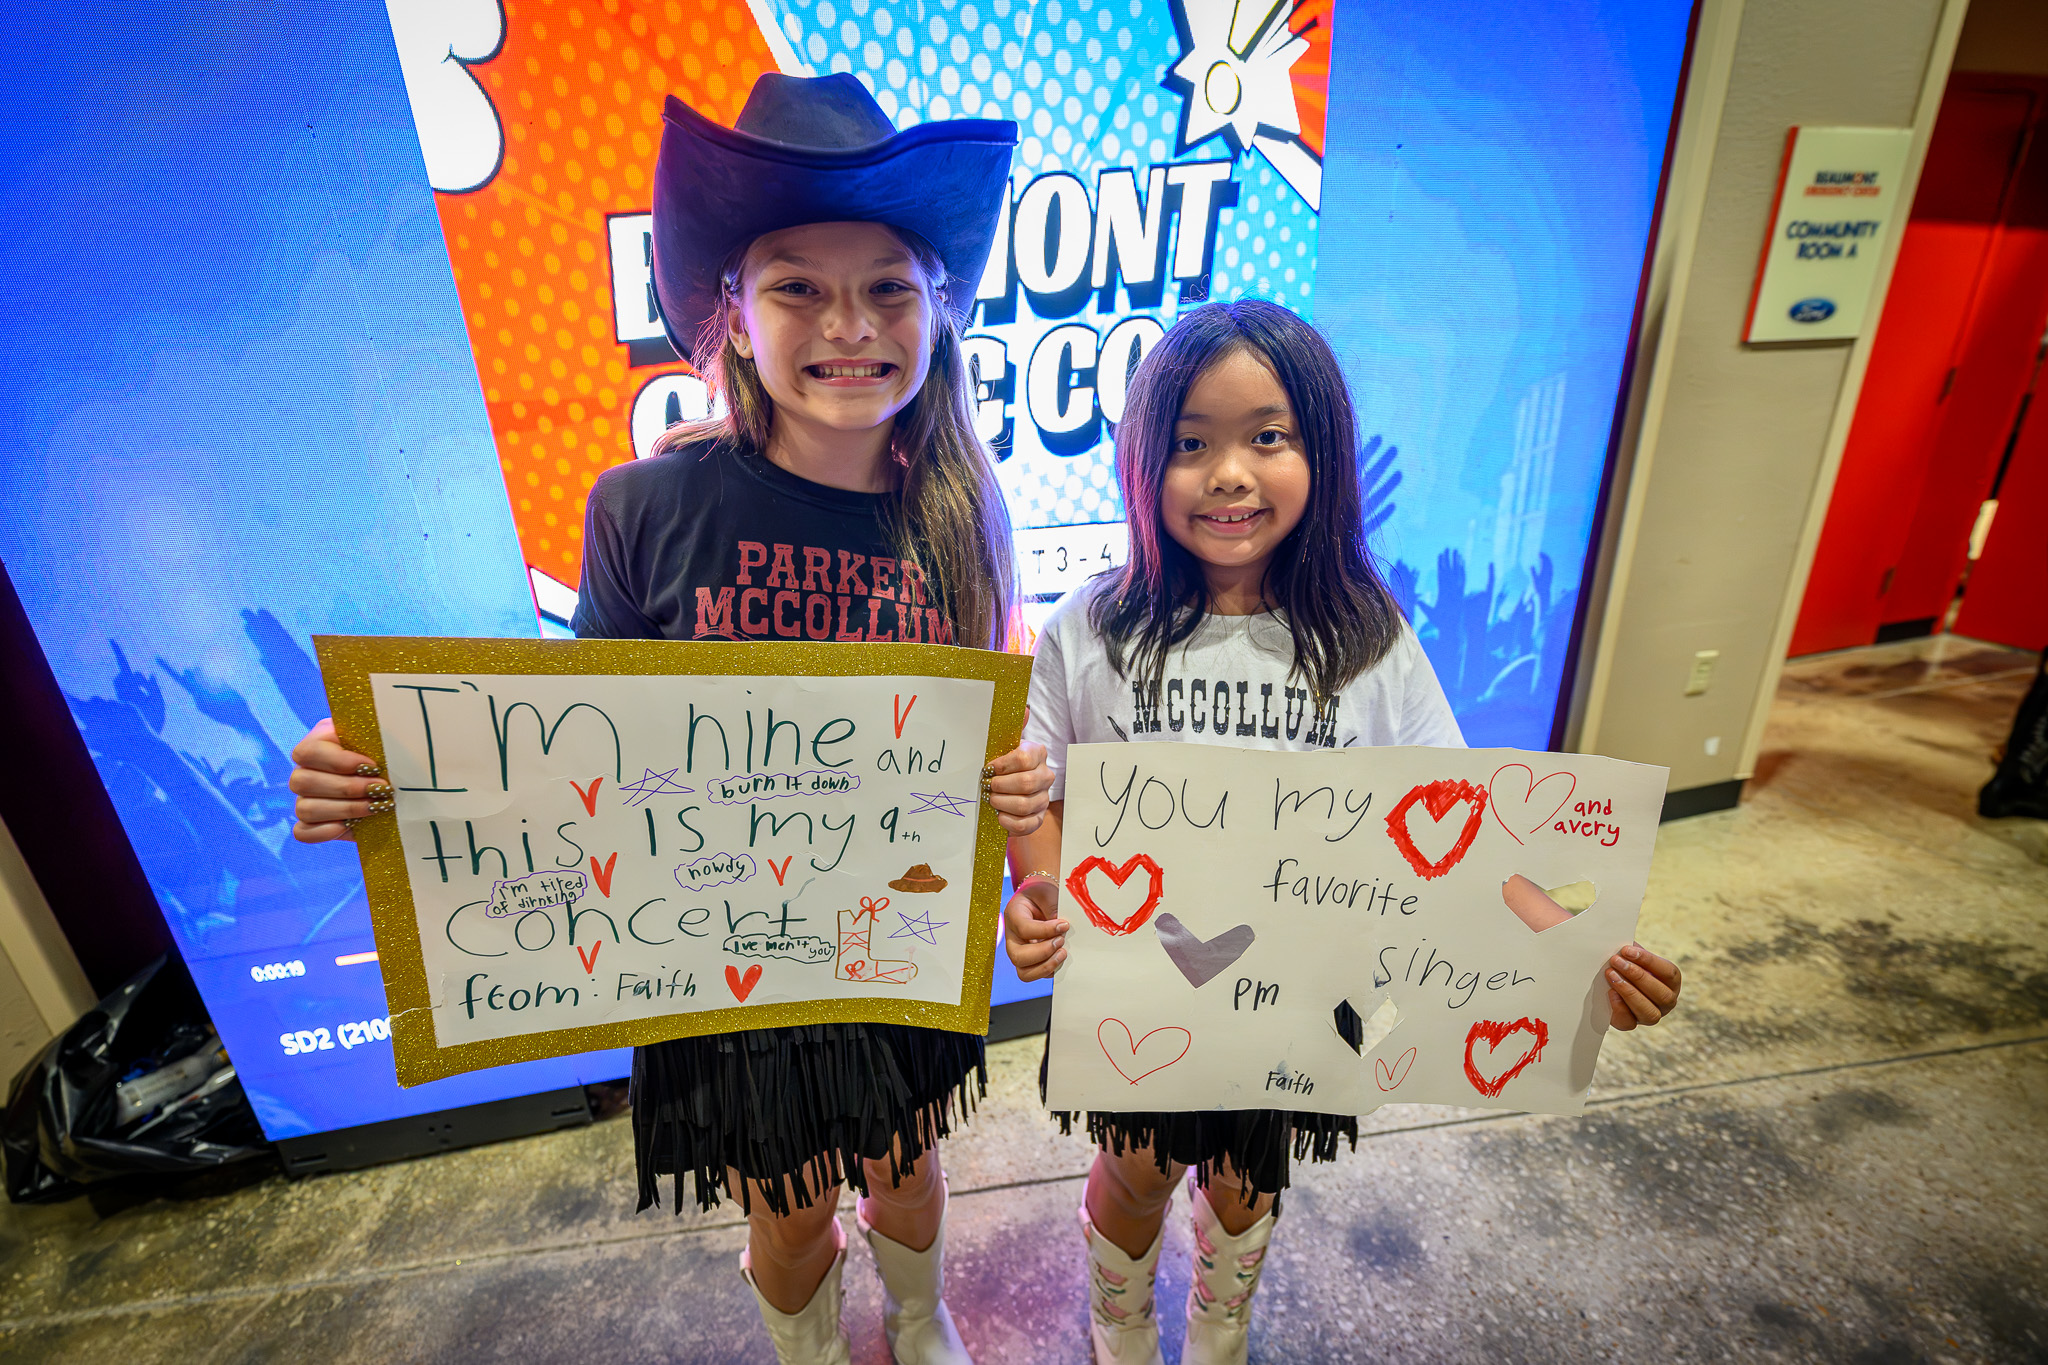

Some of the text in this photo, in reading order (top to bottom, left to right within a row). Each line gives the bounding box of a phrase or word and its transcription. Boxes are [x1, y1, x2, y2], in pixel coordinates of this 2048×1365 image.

[1786, 220, 1881, 239] COMMUNITY
[1796, 241, 1858, 260] ROOM A
[736, 540, 927, 606] PARKER
[694, 586, 952, 645] MCCOLLUM
[1132, 678, 1341, 748] MCCOLLUM
[686, 690, 857, 774] nine
[877, 739, 946, 775] and
[721, 776, 776, 799] burn
[811, 775, 850, 791] down
[1274, 777, 1372, 842] my
[1574, 798, 1613, 817] and
[422, 818, 585, 883] this
[749, 803, 856, 873] my
[1553, 819, 1620, 847] avery
[540, 876, 584, 893] tired
[492, 901, 509, 915] of
[808, 946, 831, 959] you
[616, 965, 696, 1001] Faith
[279, 1027, 336, 1056] SD2
[1265, 1070, 1314, 1096] Faith
